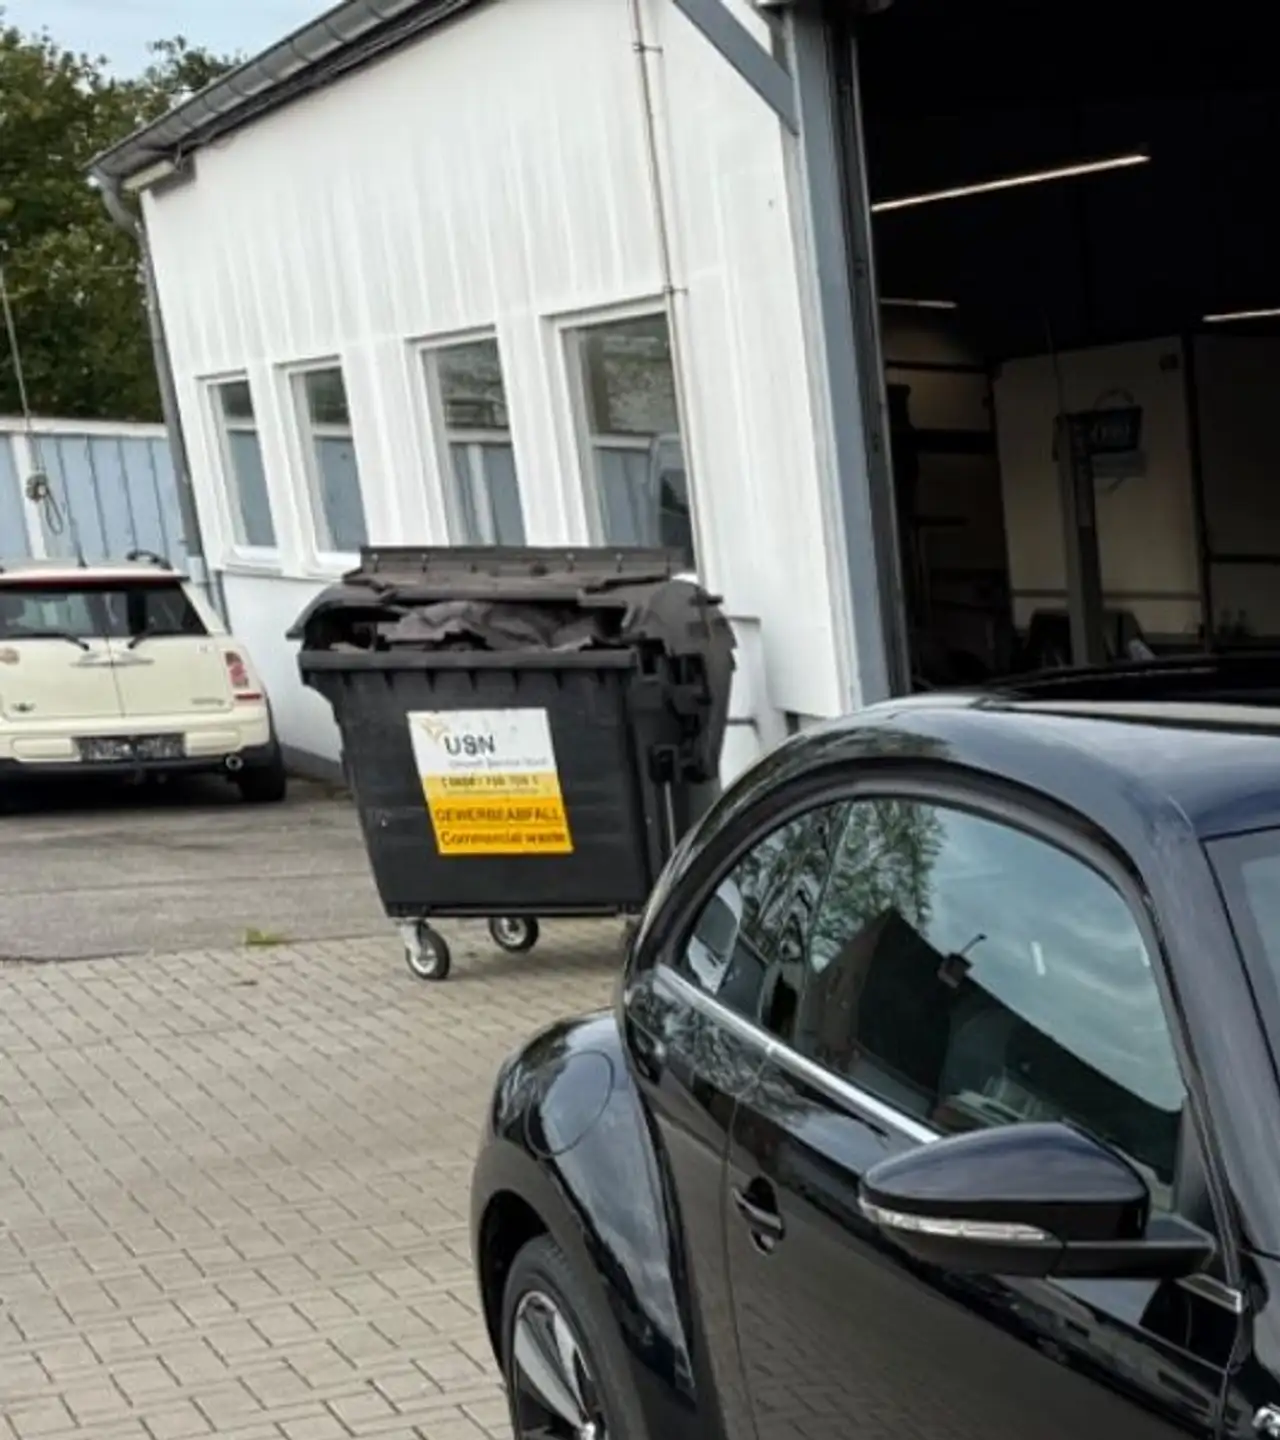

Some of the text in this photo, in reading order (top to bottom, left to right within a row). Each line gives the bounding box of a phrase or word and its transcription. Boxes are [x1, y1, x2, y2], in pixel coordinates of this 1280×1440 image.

[444, 734, 496, 756] USN
[435, 806, 560, 822] GEWERBEABFALL
[441, 831, 522, 845] Commercial
